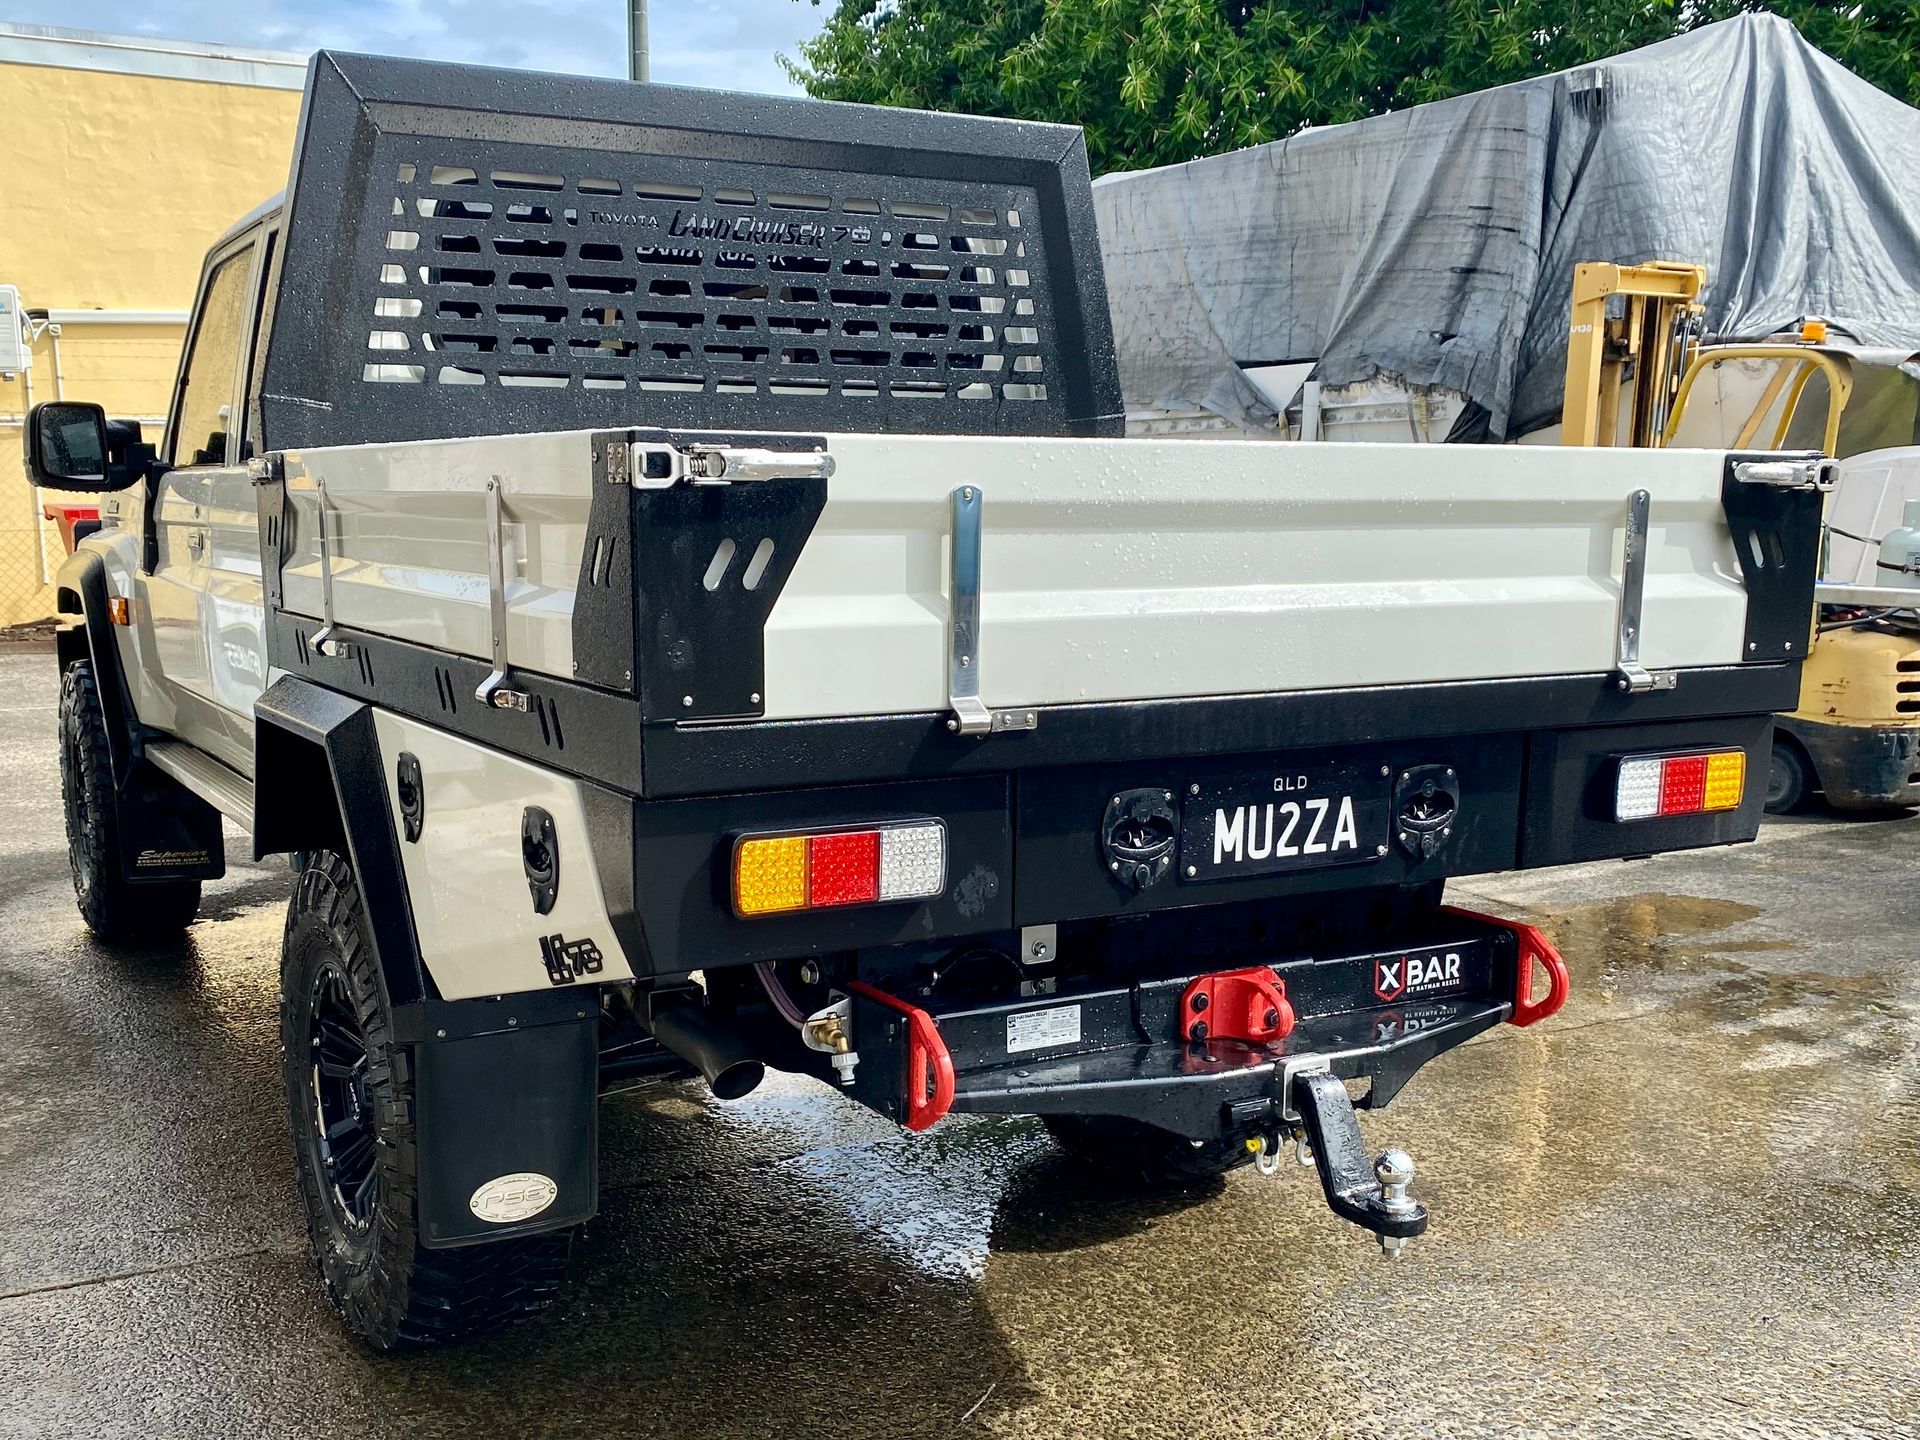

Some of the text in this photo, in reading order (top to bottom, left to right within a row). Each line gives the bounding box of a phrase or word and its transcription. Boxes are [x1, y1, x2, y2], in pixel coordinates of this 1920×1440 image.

[588, 211, 660, 229] TOYOTA
[831, 225, 872, 246] 79
[1273, 775, 1308, 792] QLD
[1213, 796, 1358, 864] MU2ZA
[484, 1185, 546, 1210] PSE
